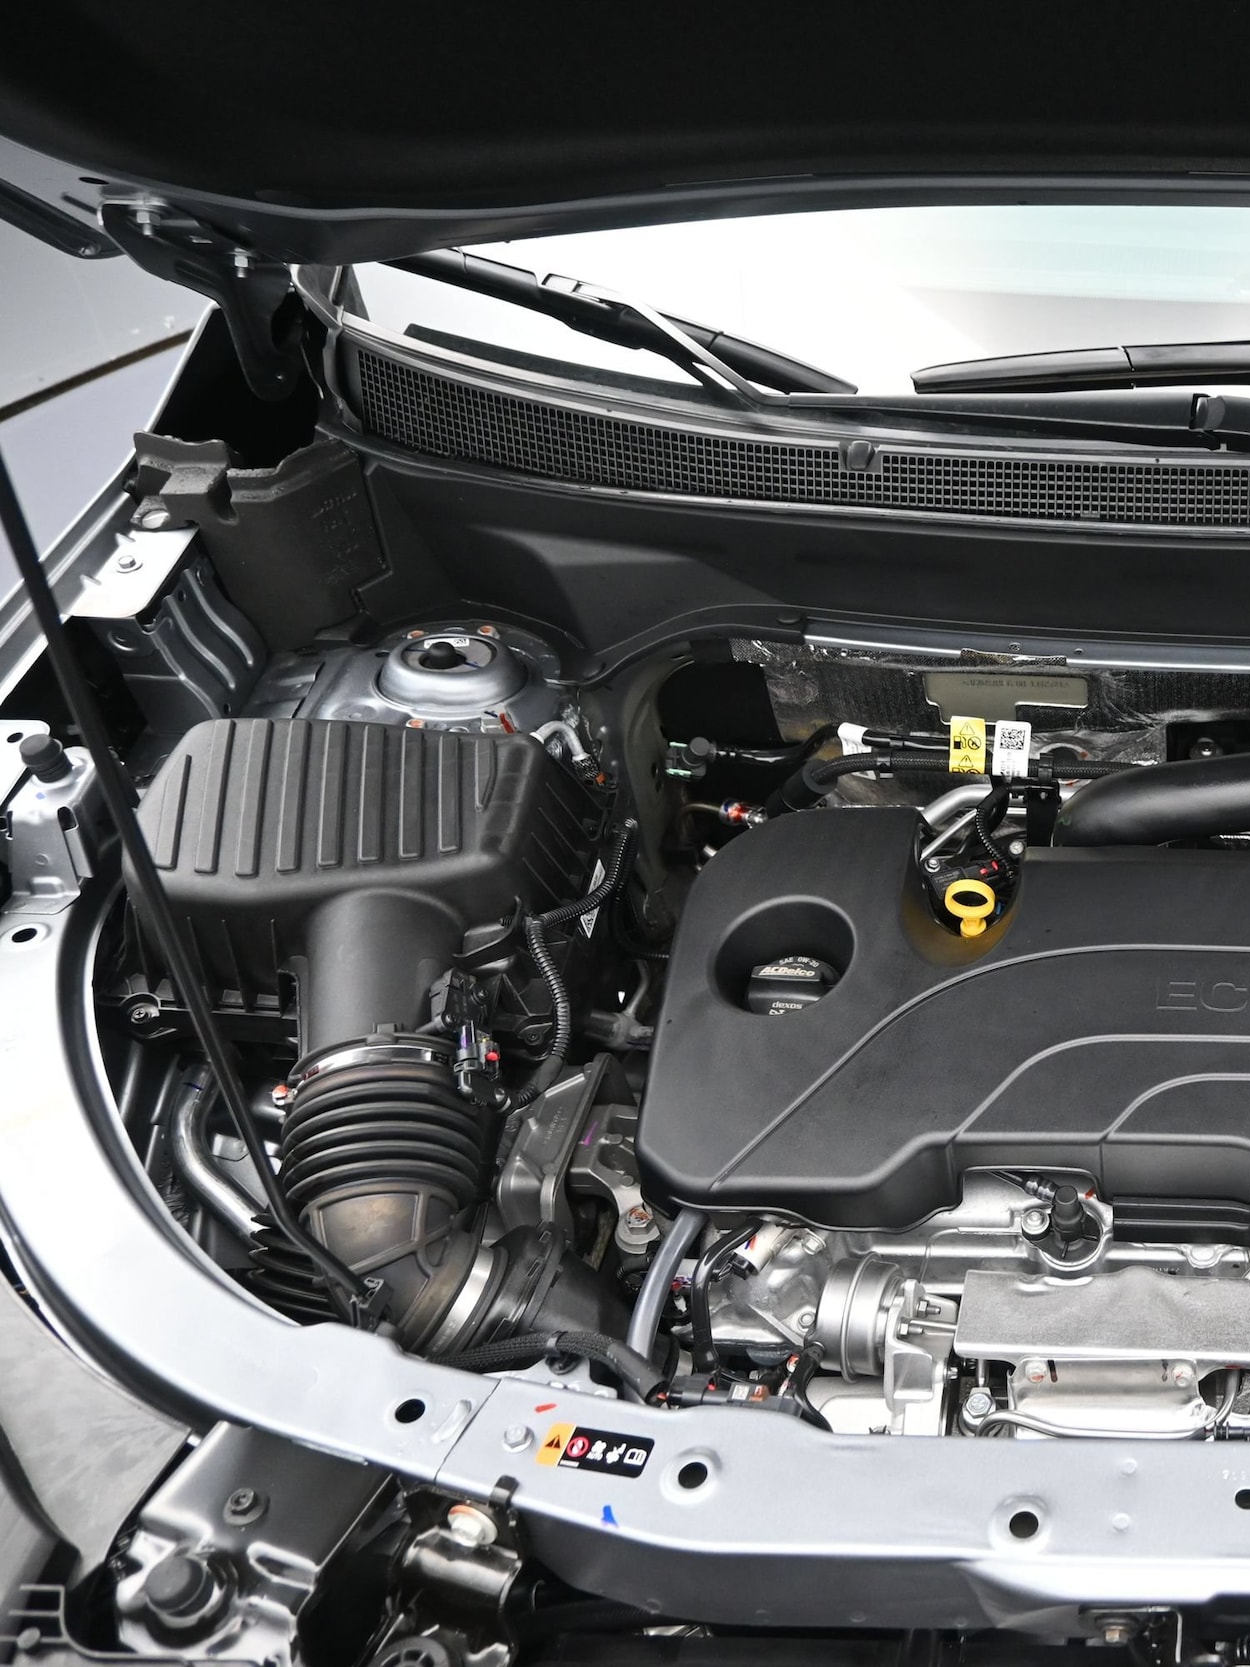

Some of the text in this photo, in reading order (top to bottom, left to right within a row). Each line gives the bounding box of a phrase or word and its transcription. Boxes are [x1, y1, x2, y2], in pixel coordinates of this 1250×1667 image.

[779, 956, 819, 968] SAE 0W-20
[758, 966, 816, 977] ACDelco
[772, 1001, 803, 1010] dexos
